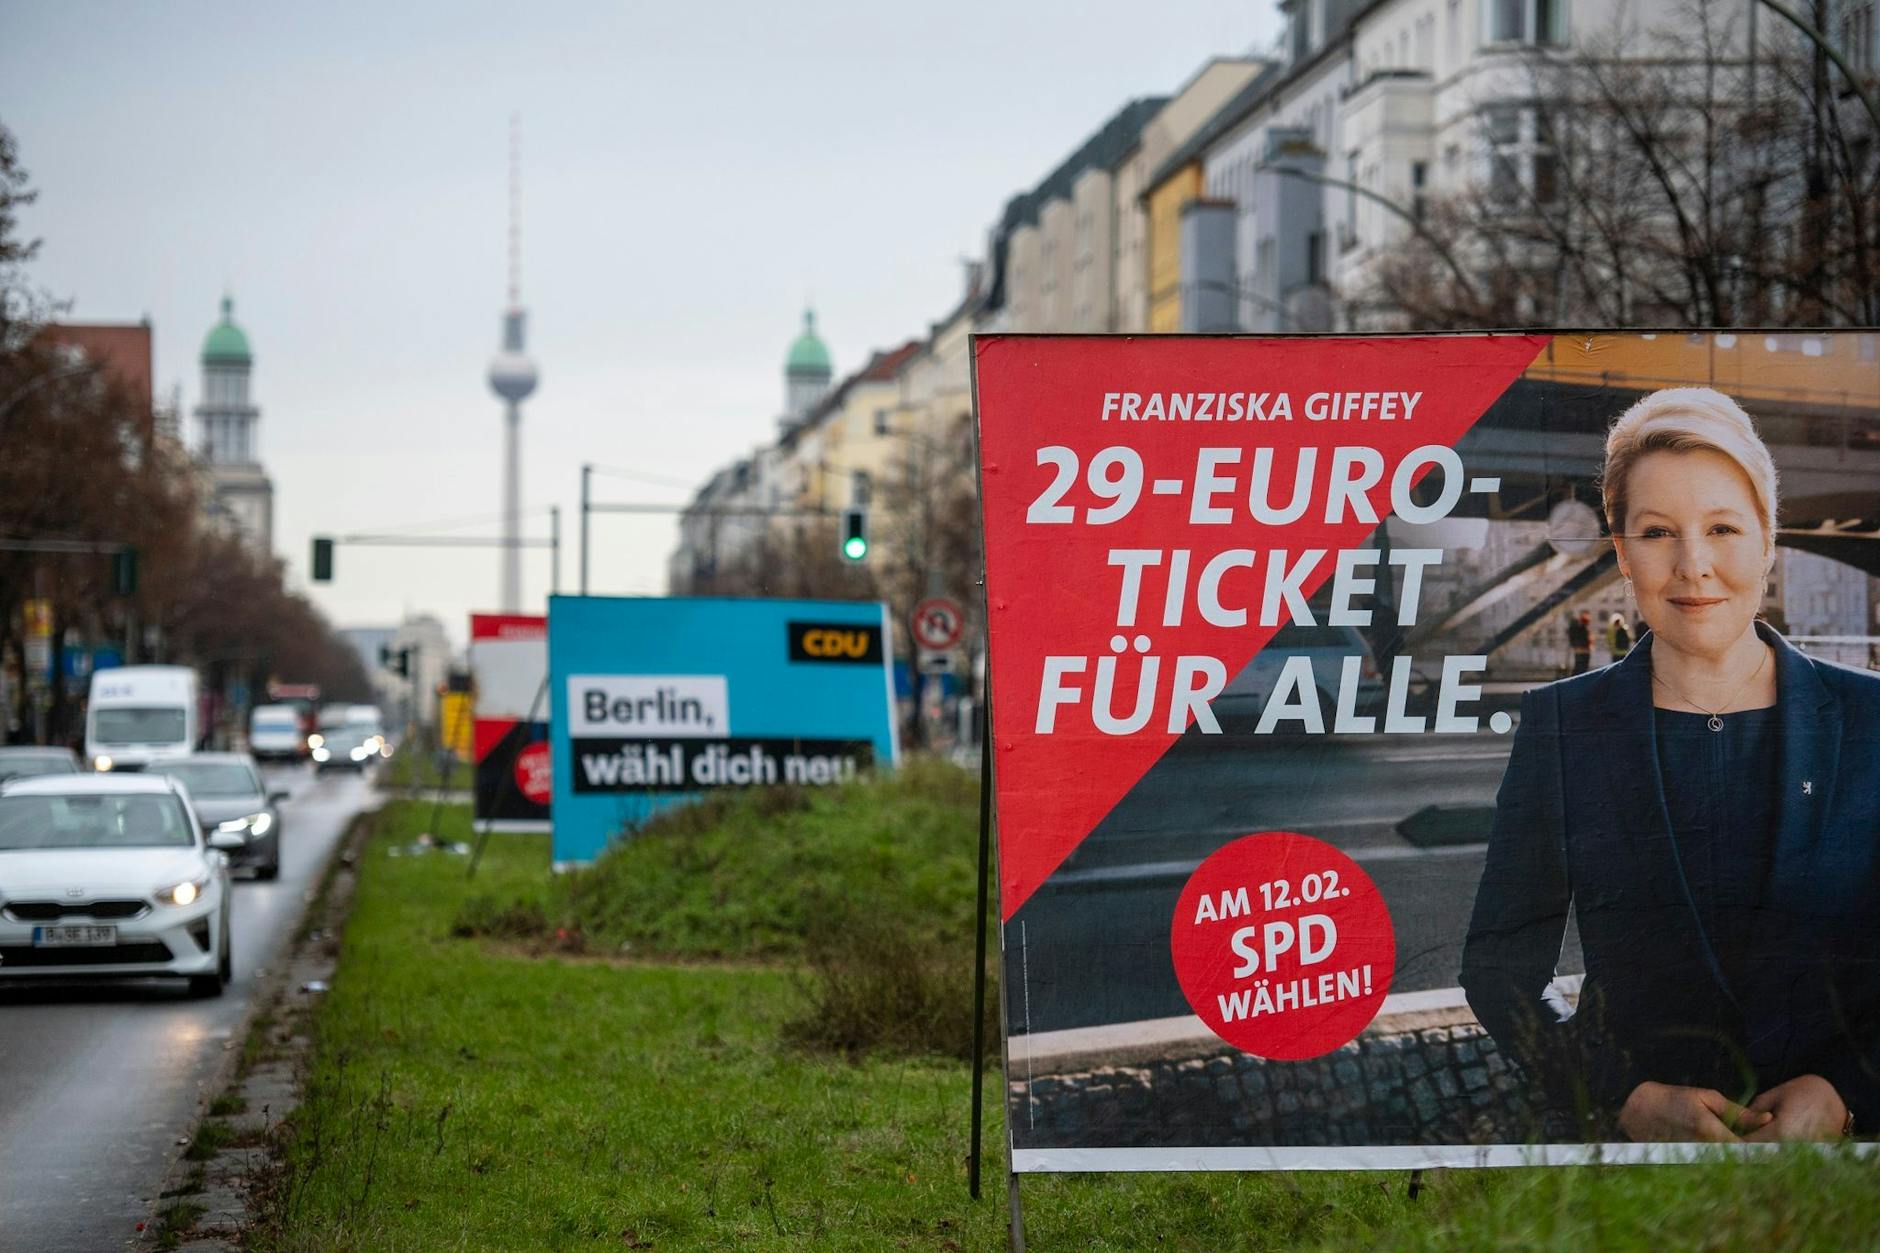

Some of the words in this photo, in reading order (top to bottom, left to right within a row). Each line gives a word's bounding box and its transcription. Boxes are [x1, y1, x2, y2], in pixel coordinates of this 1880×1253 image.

[1101, 392, 1293, 422] FRANZISKA
[1304, 391, 1423, 421] GIFFEY
[1025, 445, 1502, 526] 29-EURO-
[1107, 548, 1443, 627] TICKET
[802, 628, 871, 658] CDU
[584, 688, 715, 729] Berlin,
[1034, 634, 1228, 735] FÜR
[1253, 654, 1513, 735] ALLE.
[581, 743, 684, 786] wähl
[692, 744, 776, 785] dich
[1194, 887, 1252, 925] AM
[1258, 869, 1350, 912] 12.02.
[1230, 913, 1338, 979] SPD
[1217, 964, 1373, 1024] WÄHLEN!
